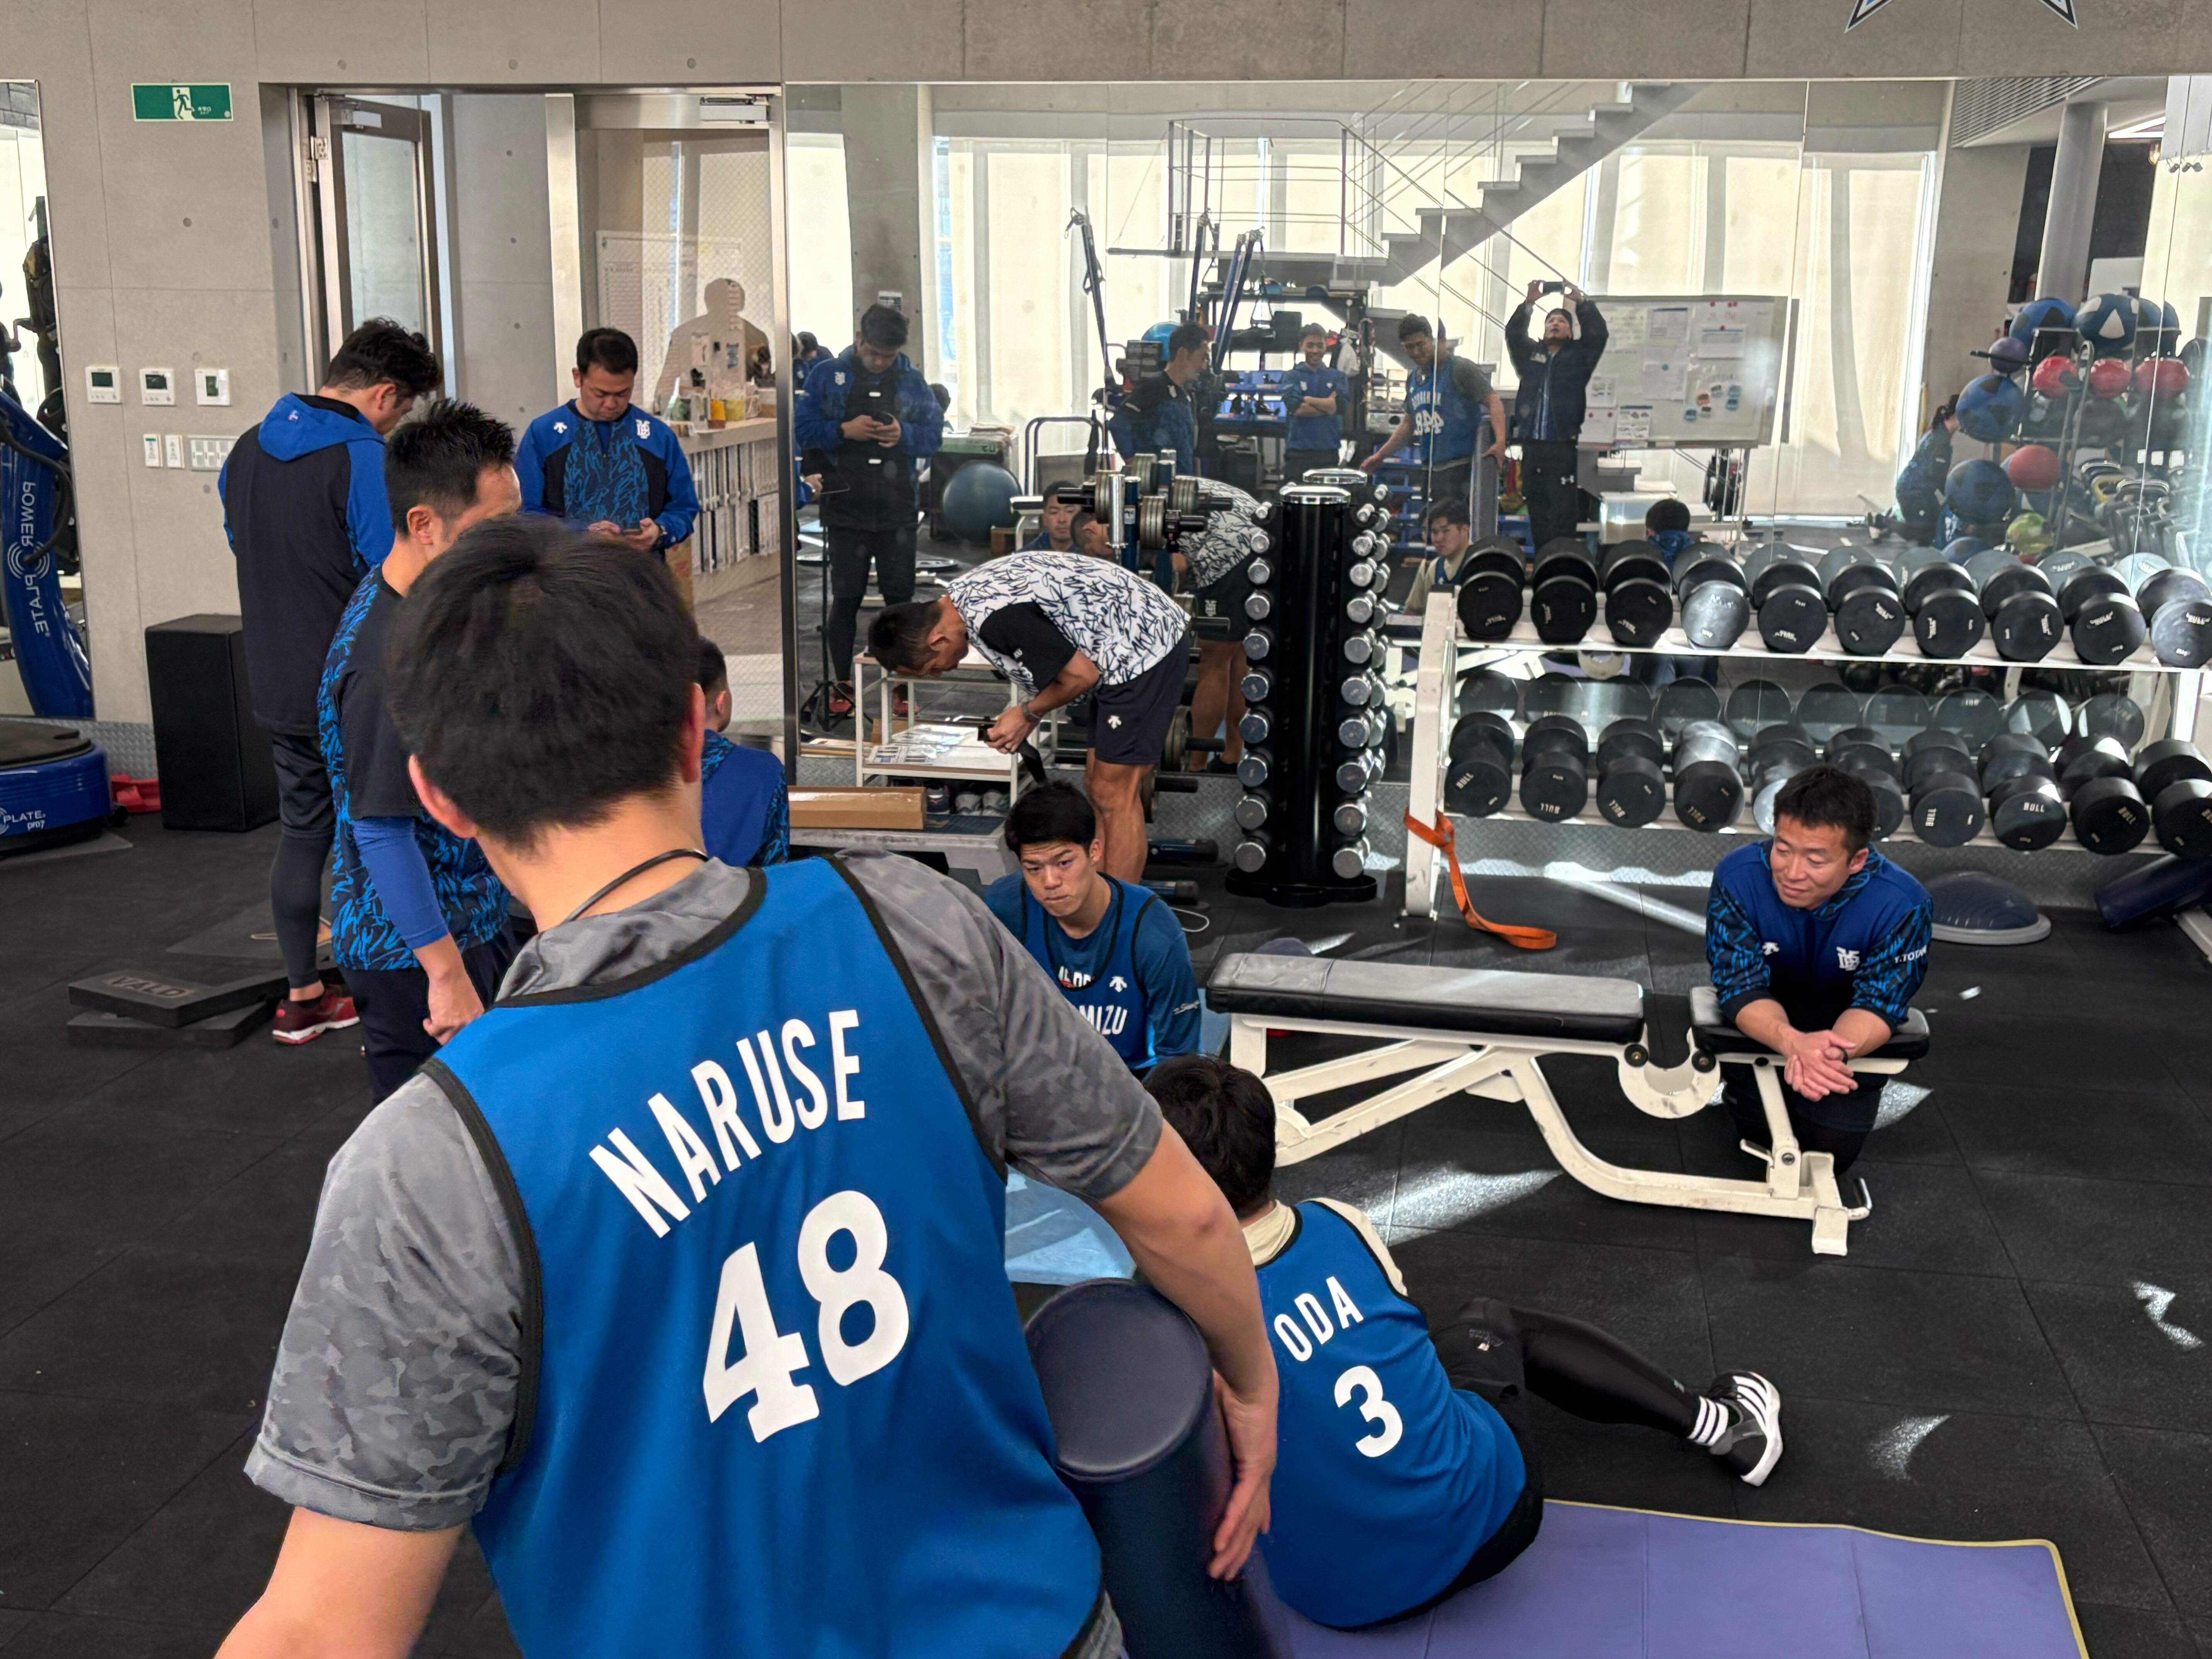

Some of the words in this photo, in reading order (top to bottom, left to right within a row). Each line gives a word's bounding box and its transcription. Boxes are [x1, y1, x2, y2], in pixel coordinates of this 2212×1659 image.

[3, 810, 43, 824] PLATE
[1540, 803, 1560, 814] BULL
[1925, 808, 1937, 826] BULL
[2023, 802, 2045, 812] BULL
[112, 977, 185, 997] VALD
[1079, 1005, 1128, 1035] MIZU
[589, 1010, 865, 1238] NARUSE
[702, 1190, 909, 1443] 48
[1274, 1276, 1364, 1362] ODA
[1334, 1365, 1403, 1457] 3
